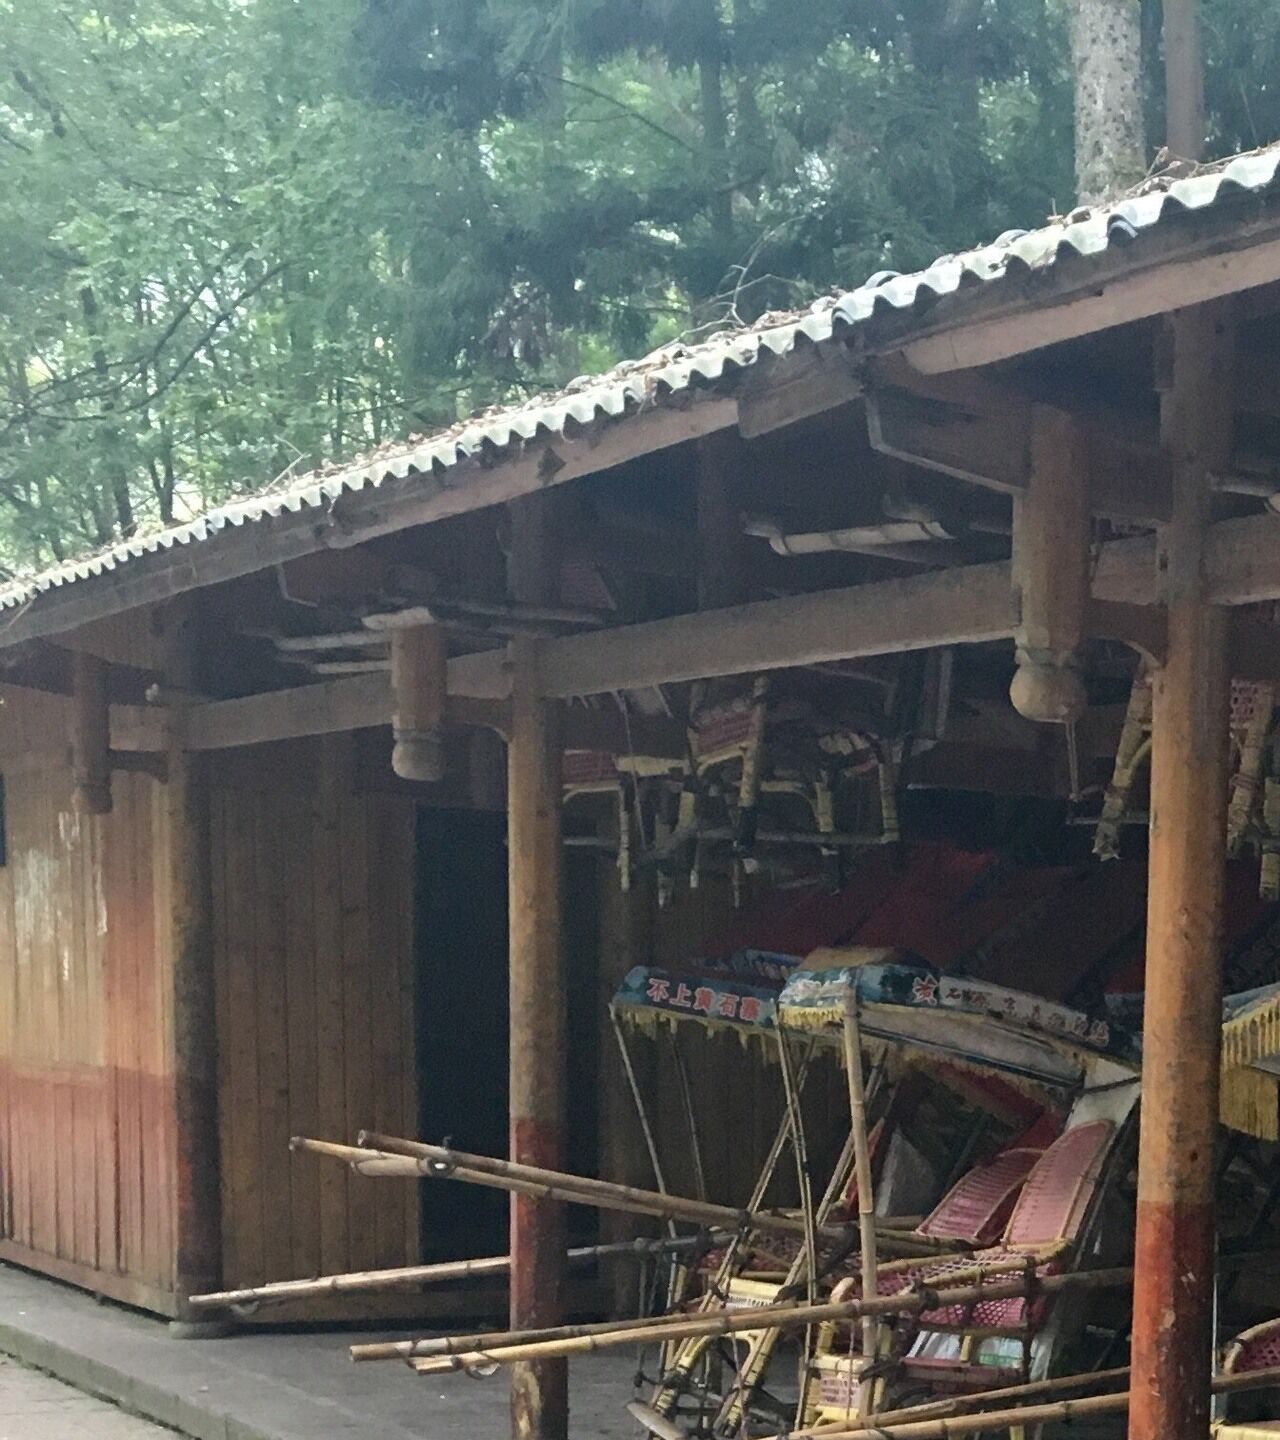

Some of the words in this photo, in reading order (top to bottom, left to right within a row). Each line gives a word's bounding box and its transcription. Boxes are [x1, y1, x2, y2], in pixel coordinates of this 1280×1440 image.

[647, 978, 761, 1021] 不上黄石寨
